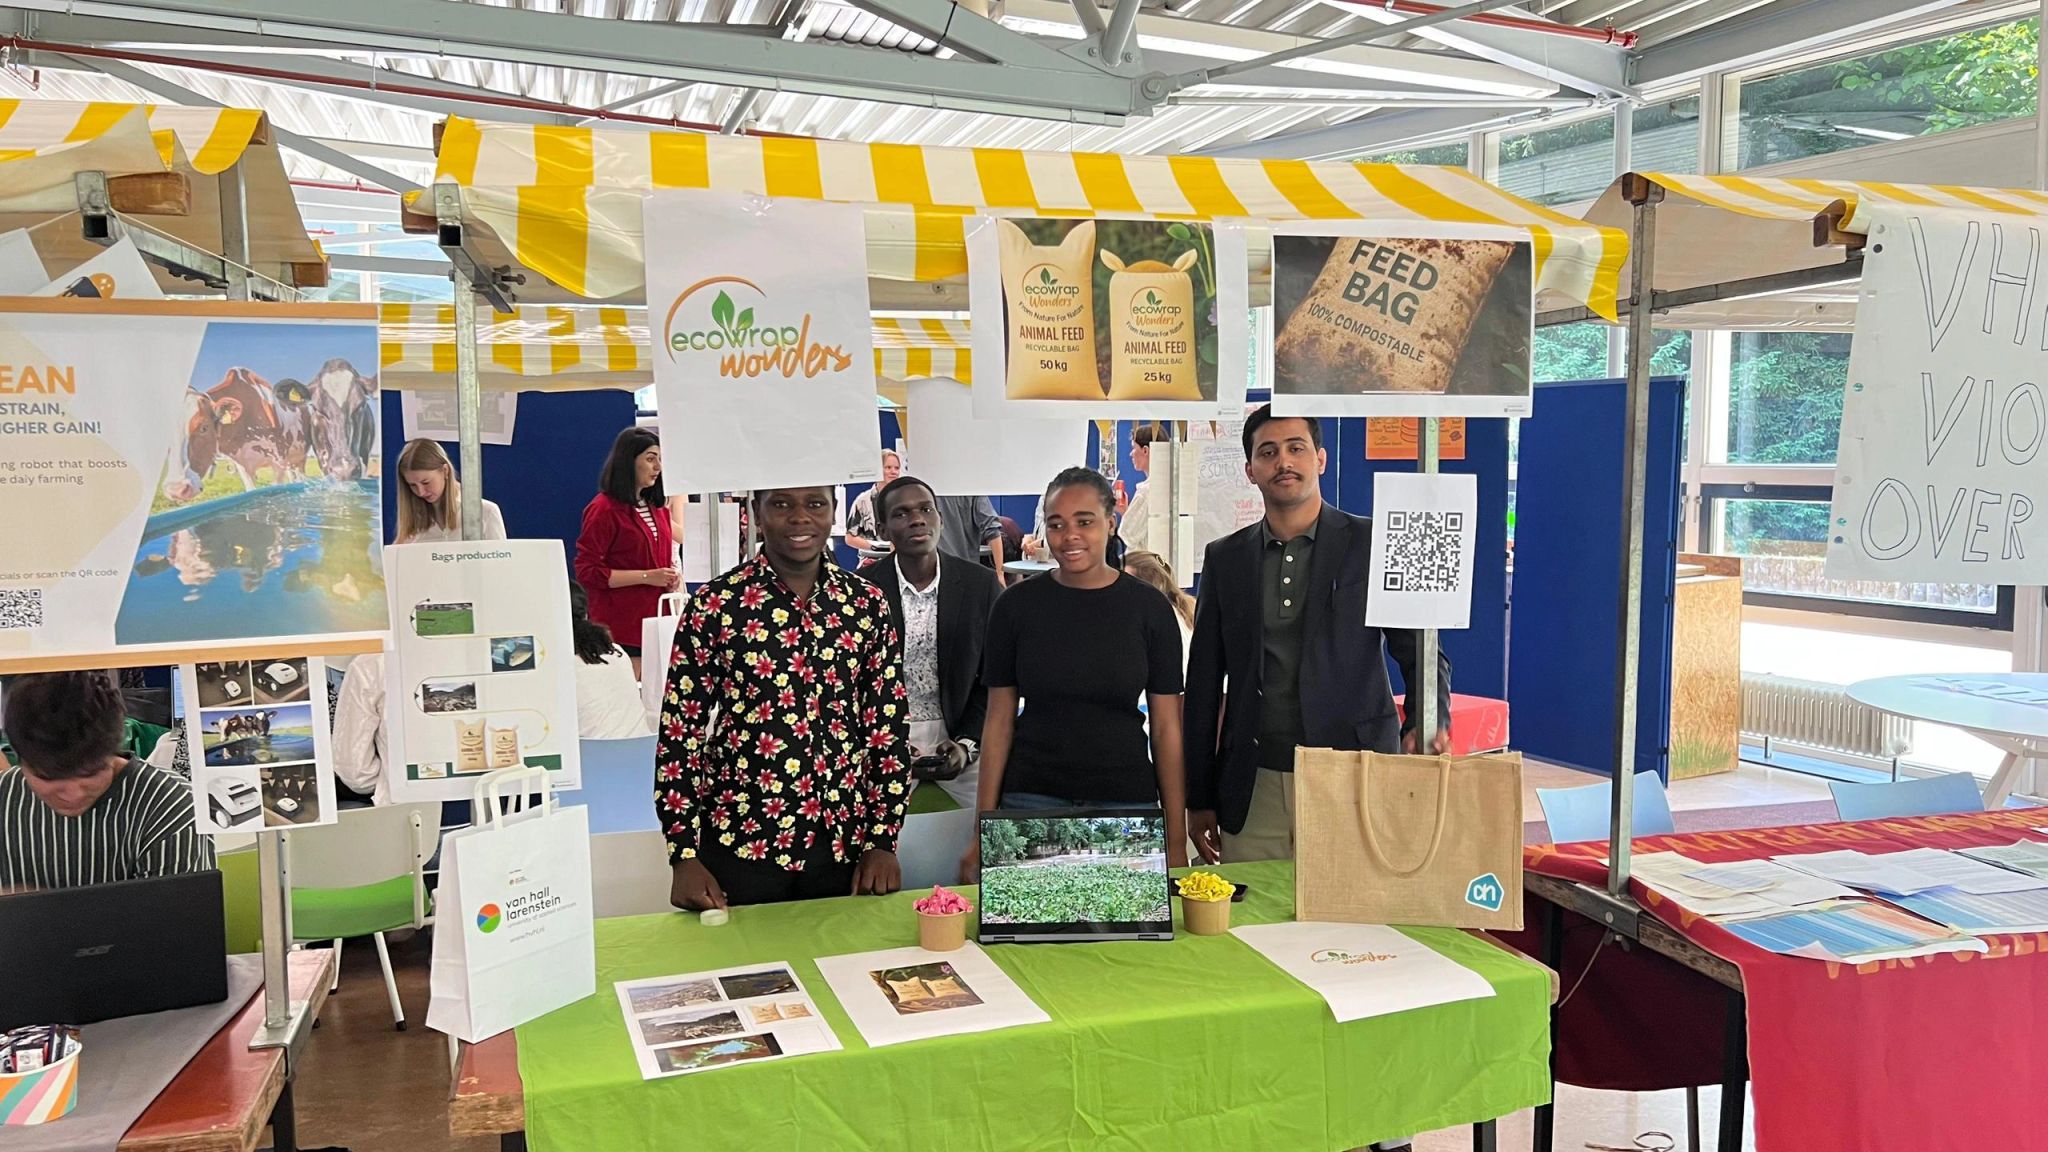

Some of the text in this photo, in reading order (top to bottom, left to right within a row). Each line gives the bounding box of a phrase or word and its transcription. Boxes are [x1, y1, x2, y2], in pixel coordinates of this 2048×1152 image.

[1348, 239, 1438, 291] FEED
[1908, 216, 2048, 352] VH
[1025, 285, 1080, 298] ecowrap
[1029, 295, 1072, 308] Wonders
[1342, 271, 1420, 326] BAG
[1033, 312, 1056, 323] Nature
[1056, 314, 1067, 322] For
[1132, 305, 1182, 317] ecowrap
[1135, 314, 1175, 326] Wonders
[671, 325, 799, 352] ecowrap
[1019, 325, 1085, 341] ANIMAL FEED
[1307, 303, 1425, 362] 100% COMPOSTABLE
[720, 313, 852, 379] wonders
[1025, 343, 1065, 353] RECYCLABLE
[1124, 341, 1187, 354] ANIMAL FEED
[1040, 359, 1068, 372] 50 kg
[0, 365, 76, 394] EAN
[1144, 371, 1172, 384] 25 kg
[0, 402, 65, 417] STRAIN,
[53, 421, 102, 434] GAIN!
[20, 460, 54, 470] robot
[58, 460, 83, 469] that
[88, 459, 128, 469] boosts
[38, 473, 84, 486] farming
[1861, 478, 2034, 562] OVER
[431, 549, 512, 563] Bags production
[22, 572, 33, 580] or
[35, 571, 59, 579] scan
[60, 570, 77, 578] the
[78, 569, 94, 578] QR
[95, 568, 119, 577] code
[505, 886, 550, 909] van hall
[506, 895, 561, 921] larenstein
